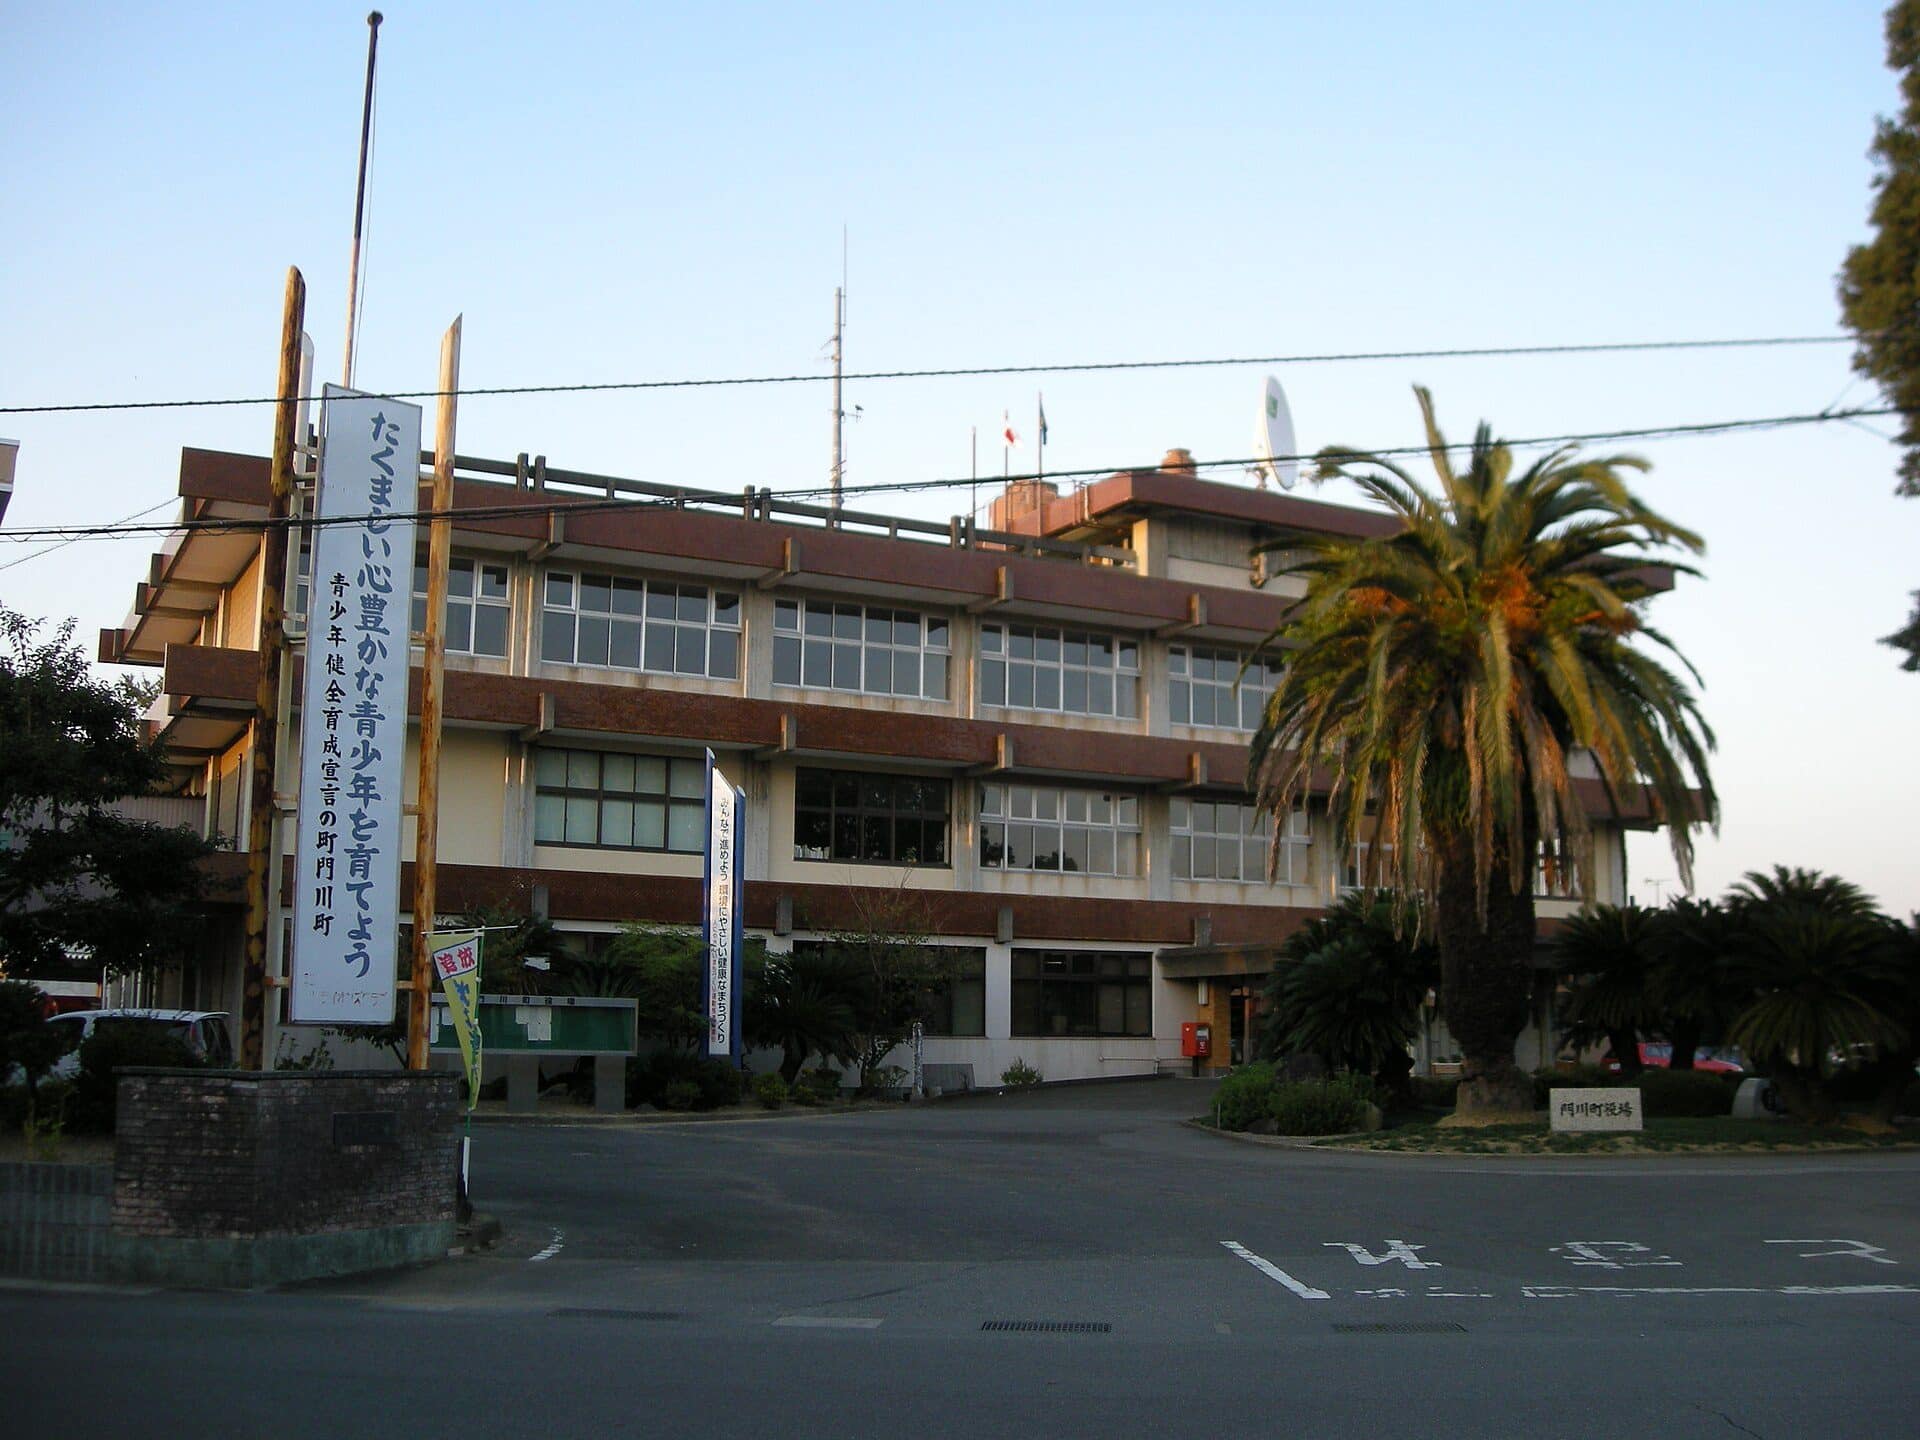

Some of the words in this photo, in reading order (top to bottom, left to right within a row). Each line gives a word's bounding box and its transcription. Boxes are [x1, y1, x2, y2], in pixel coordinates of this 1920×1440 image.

[312, 570, 351, 938] 青少年健全育成宣言の町門川町
[343, 410, 401, 978] たくましい心豊かな青少年を育てよう
[1560, 1101, 1633, 1118] 門川町役場
